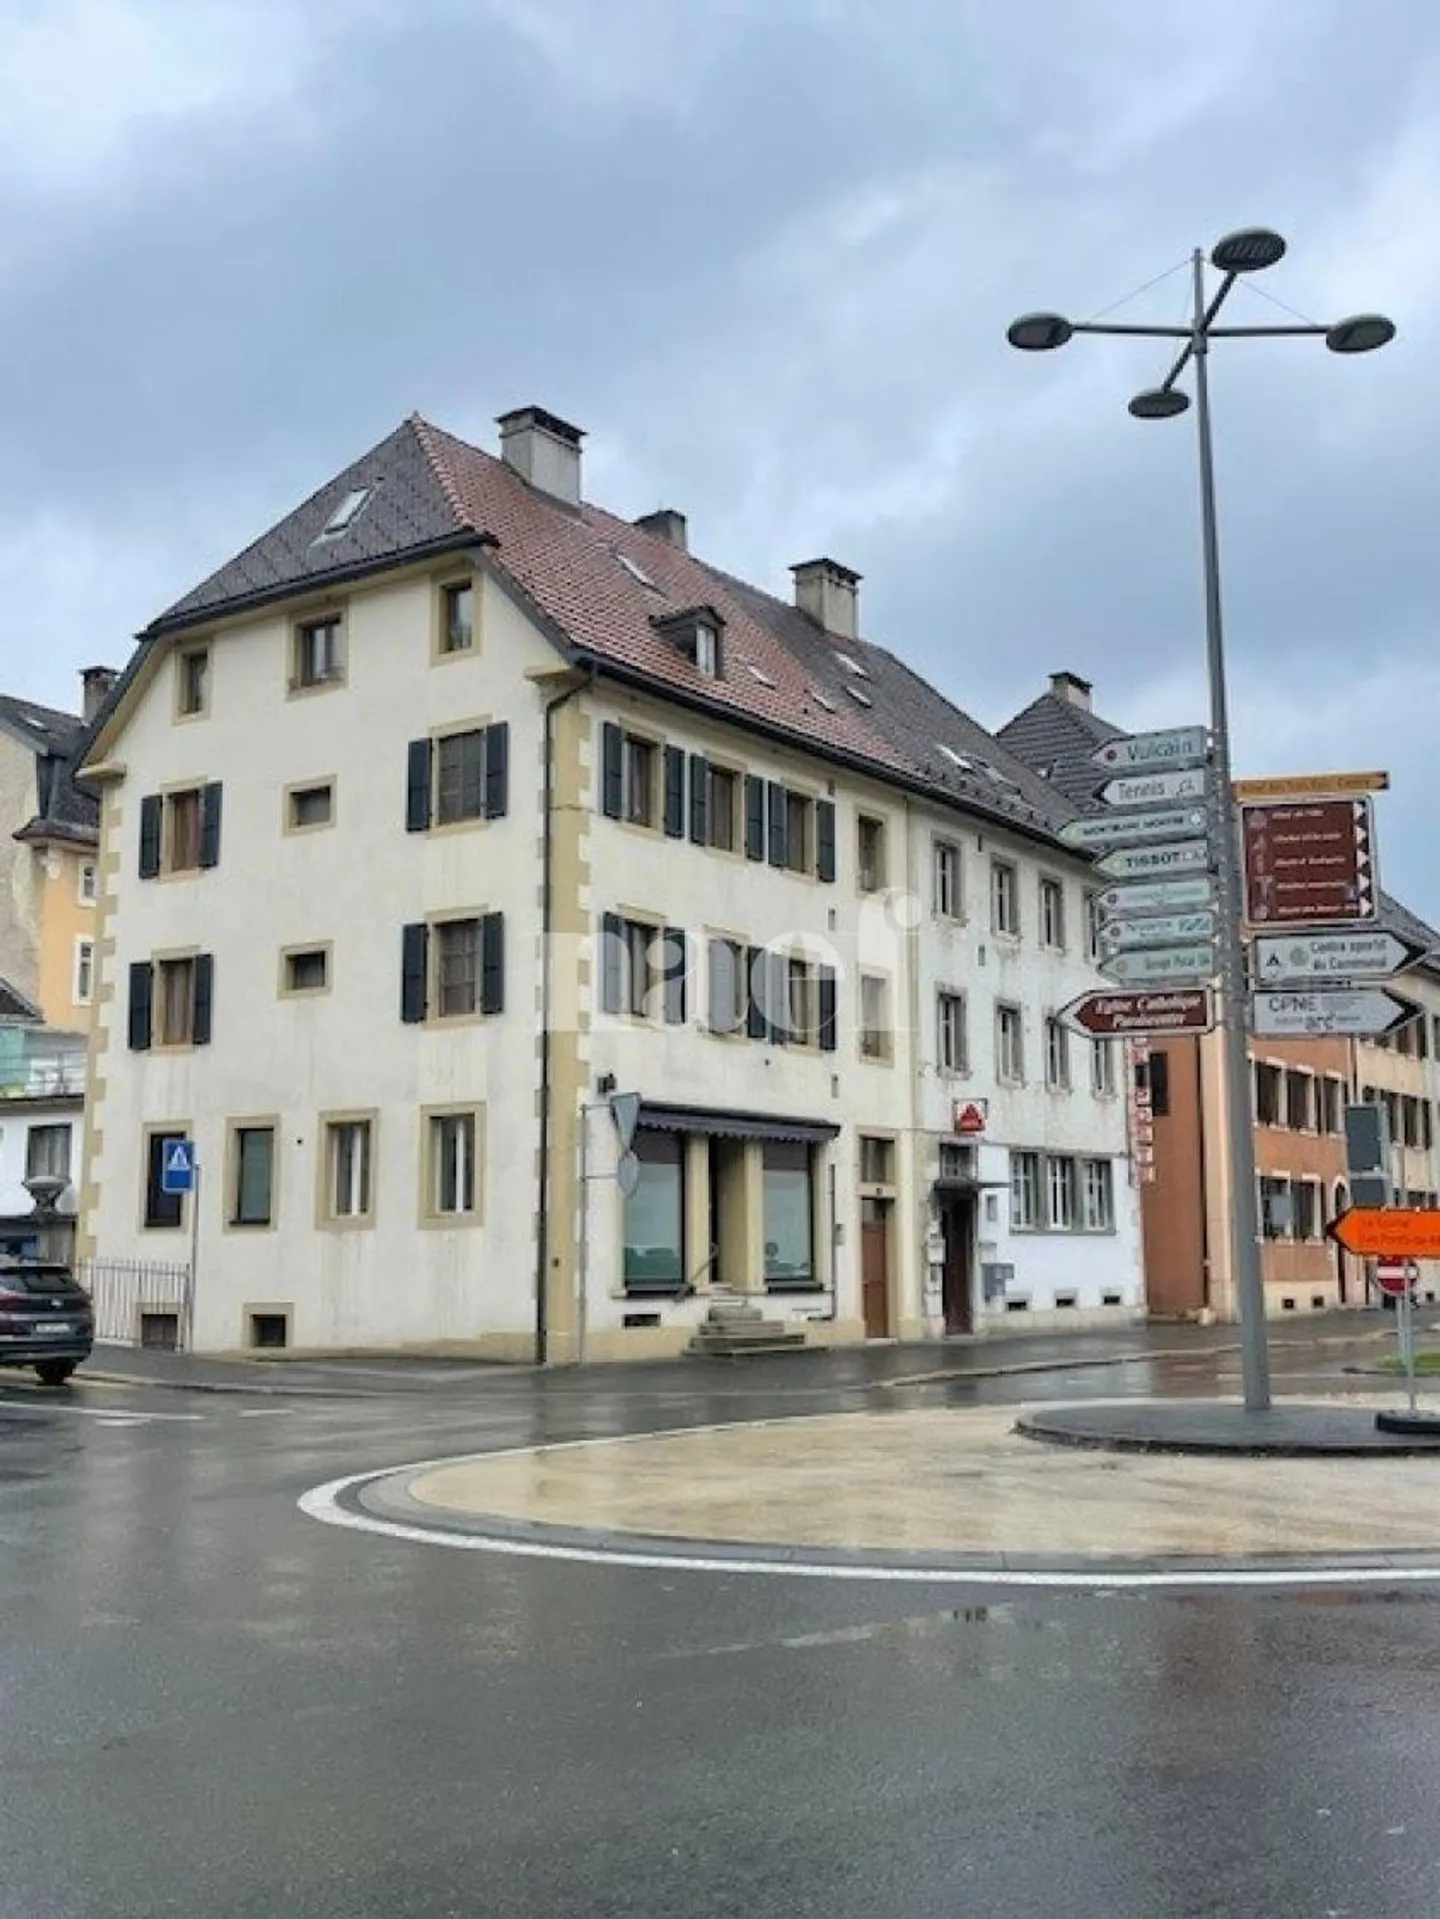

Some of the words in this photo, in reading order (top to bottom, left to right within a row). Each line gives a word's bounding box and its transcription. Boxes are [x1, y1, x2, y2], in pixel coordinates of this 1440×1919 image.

[1127, 739, 1192, 761] Vulcain
[1118, 781, 1165, 799] Tennis
[1125, 851, 1180, 868] TISSOT
[1269, 996, 1317, 1012] CPNE
